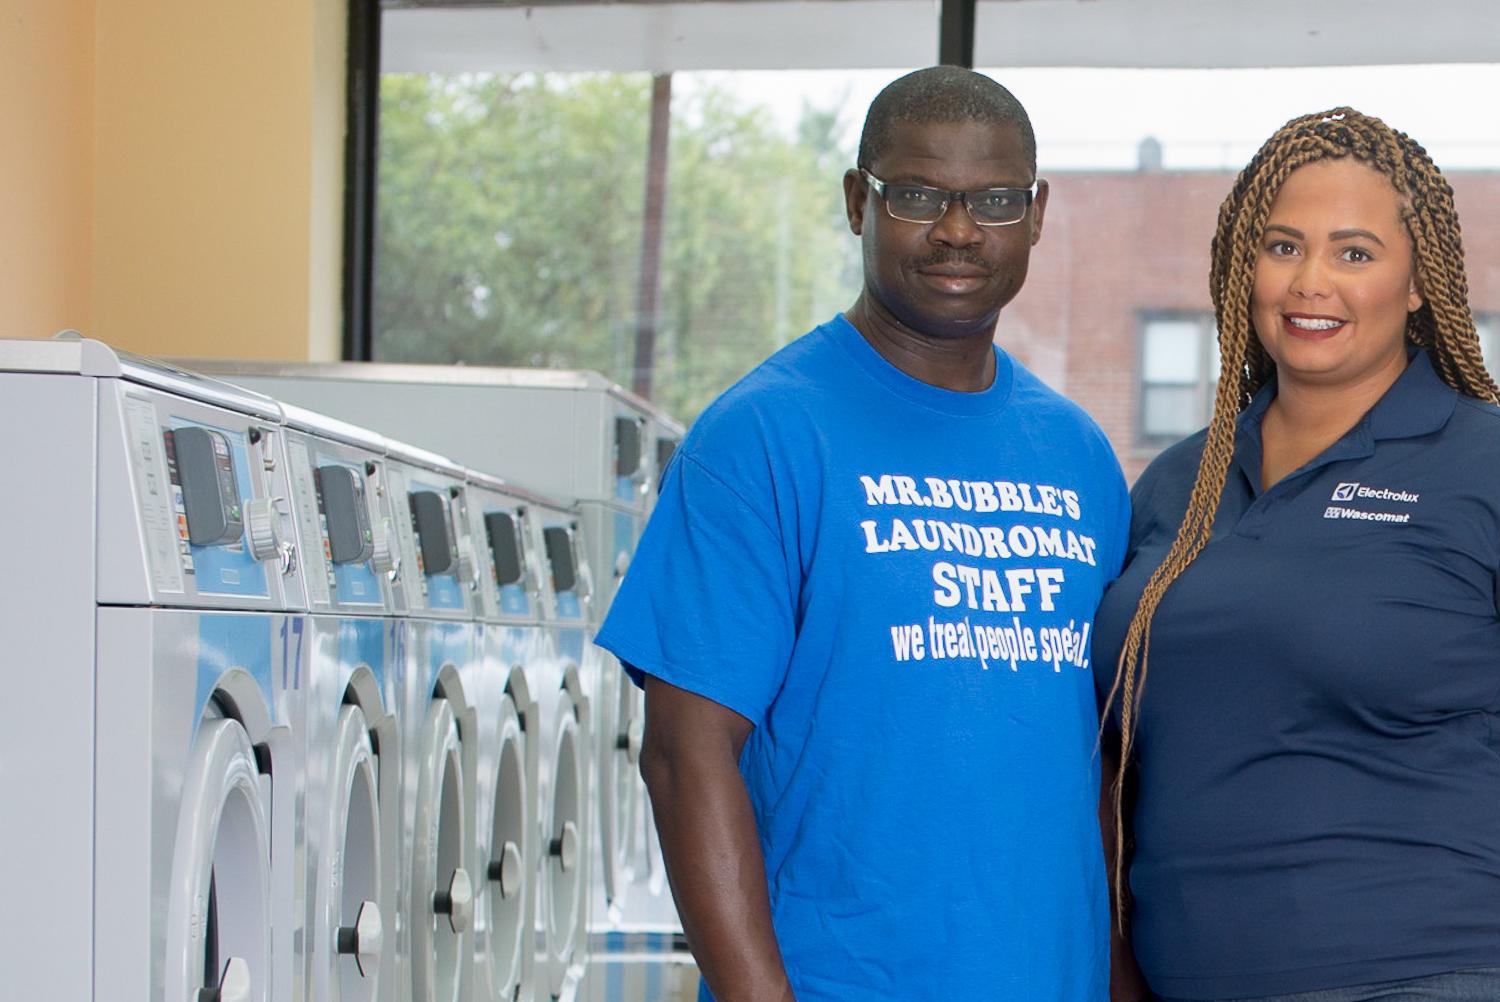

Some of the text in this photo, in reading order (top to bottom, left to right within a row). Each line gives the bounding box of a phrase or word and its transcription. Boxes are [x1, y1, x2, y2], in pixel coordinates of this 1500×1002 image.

[860, 475, 1081, 520] MR.BUBBLE'S
[1340, 508, 1411, 523] Wascomat
[1357, 486, 1420, 503] Electrolux
[860, 518, 1097, 566] LAUNDROMAT
[932, 561, 1065, 612] STAFF
[279, 616, 304, 690] 17
[890, 623, 926, 661] we
[974, 616, 1038, 672] people
